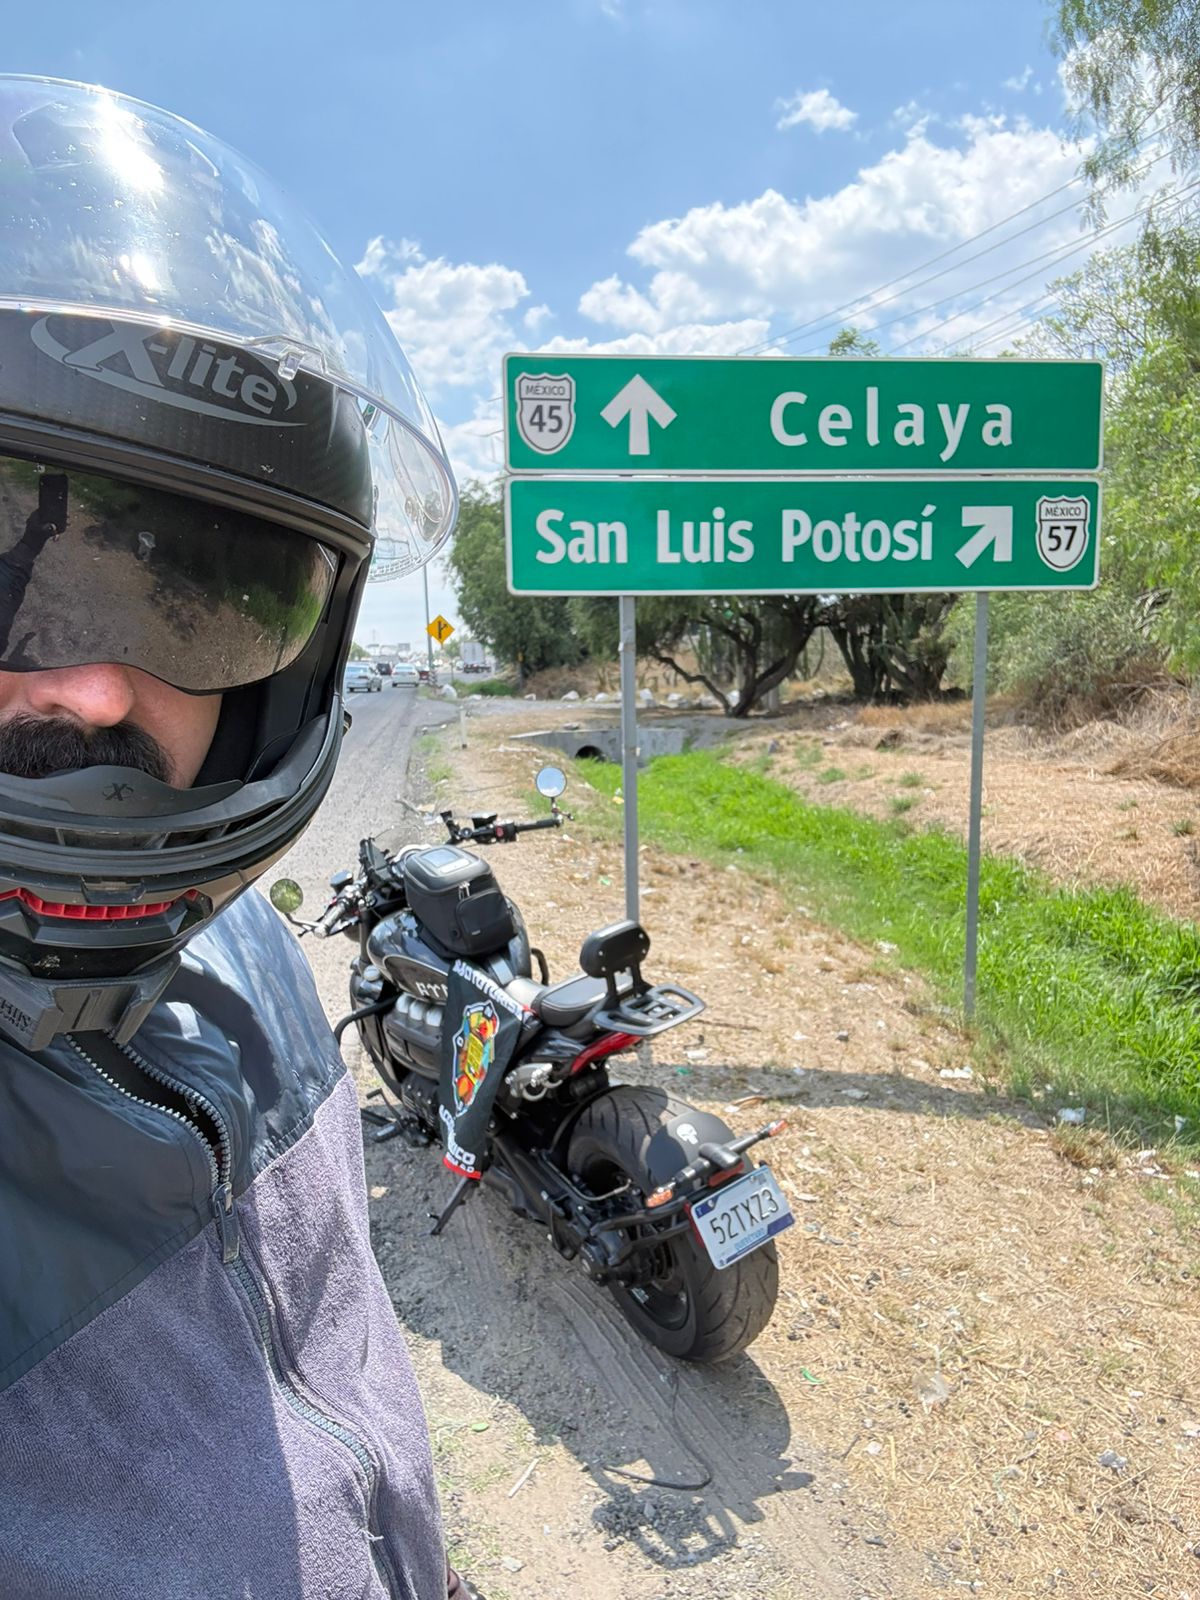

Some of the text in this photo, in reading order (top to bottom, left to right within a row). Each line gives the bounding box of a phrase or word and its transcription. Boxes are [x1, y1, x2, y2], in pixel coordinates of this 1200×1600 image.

[62, 318, 278, 415] X-lite
[525, 382, 566, 396] MÉXICO
[529, 404, 563, 434] 45
[769, 386, 1013, 462] Celaya
[1044, 506, 1082, 517] MÉXICO
[534, 504, 937, 564] San Luis Potosí
[1047, 525, 1078, 552] 57
[709, 1188, 779, 1245] 52TXZ3
